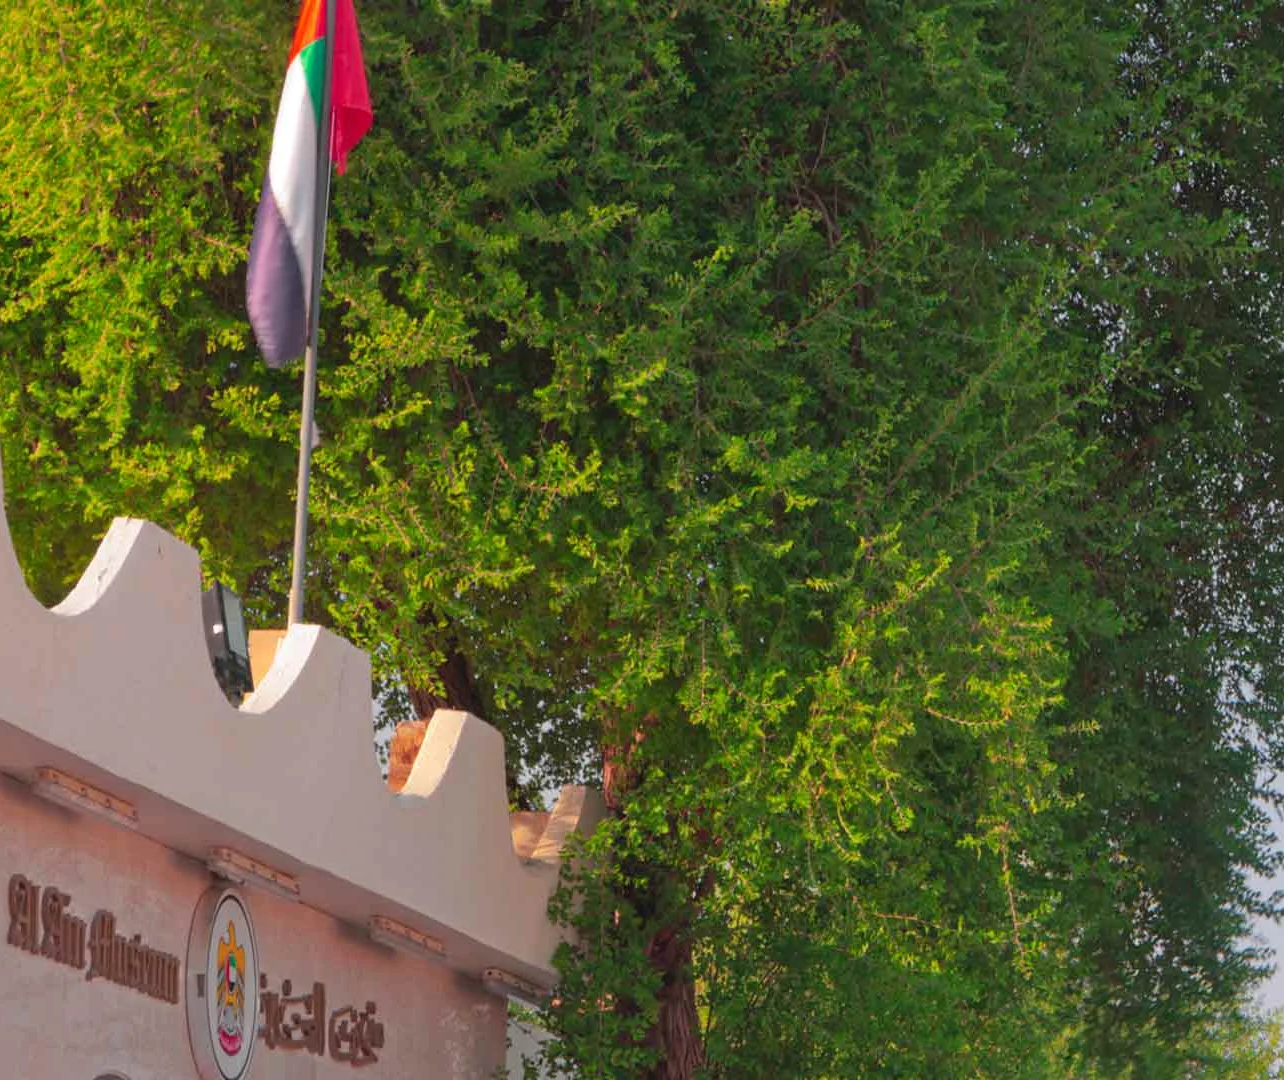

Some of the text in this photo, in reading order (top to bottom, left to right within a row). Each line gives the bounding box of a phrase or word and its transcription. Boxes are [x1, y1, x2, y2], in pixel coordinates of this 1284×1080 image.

[7, 873, 180, 1005] Al Ain Museum
